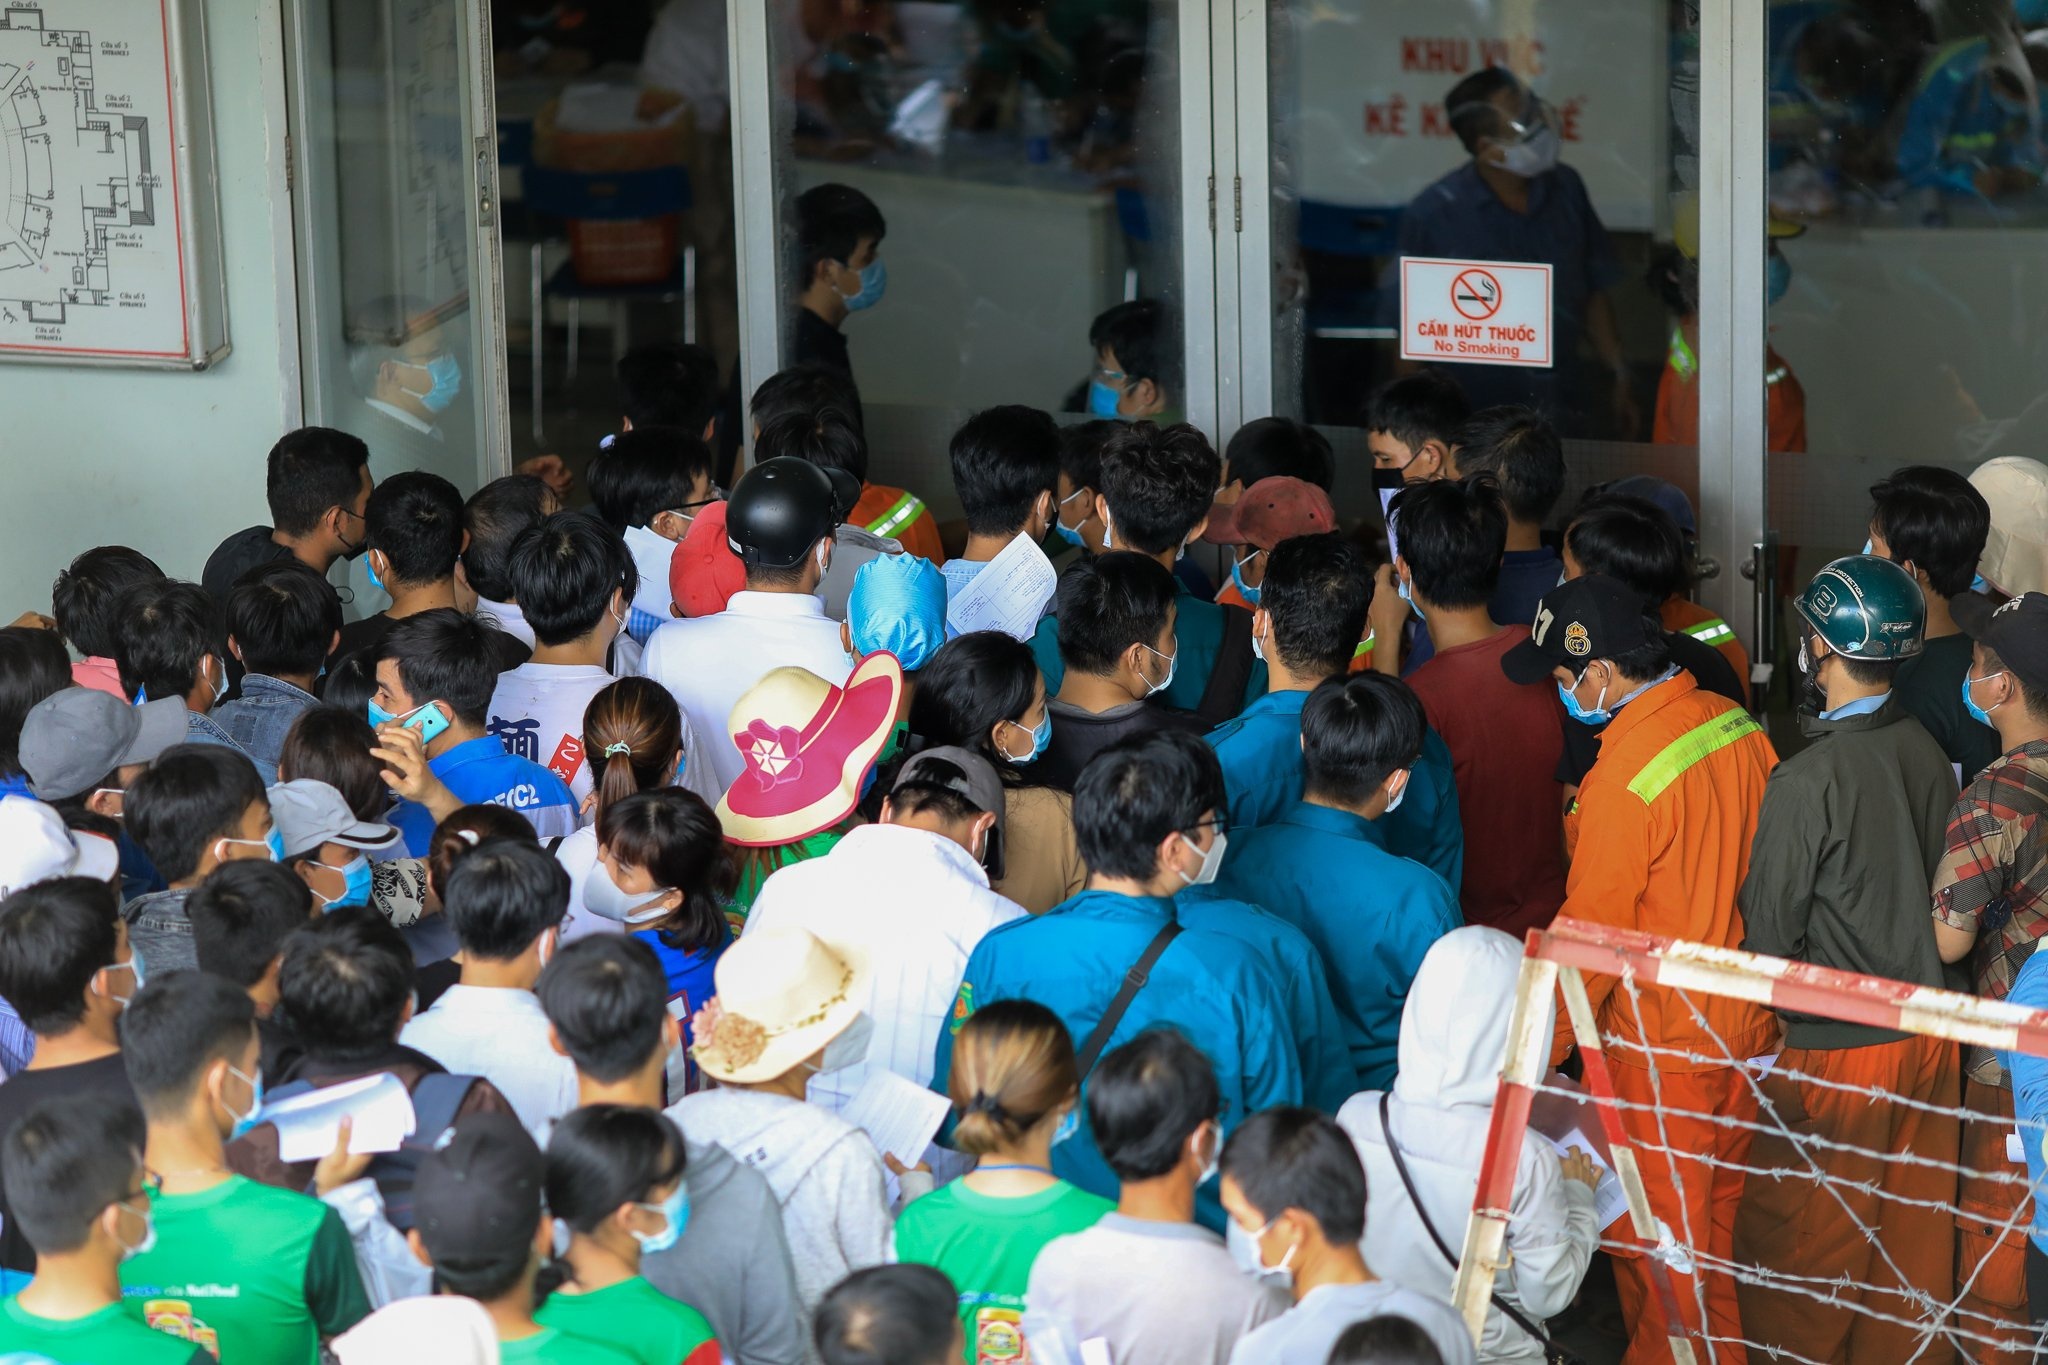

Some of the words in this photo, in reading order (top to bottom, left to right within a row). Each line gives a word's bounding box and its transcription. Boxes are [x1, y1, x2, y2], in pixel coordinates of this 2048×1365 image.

[1402, 38, 1469, 75] KHU
[1364, 92, 1408, 137] KÊ
[1418, 319, 1448, 337] CẤM
[1454, 322, 1482, 339] HÚT
[1488, 323, 1536, 342] THUỐC
[1434, 340, 1453, 352] No
[1458, 341, 1520, 359] Smoking
[1834, 568, 1865, 598] PROTECTION
[1812, 584, 1838, 617] 8
